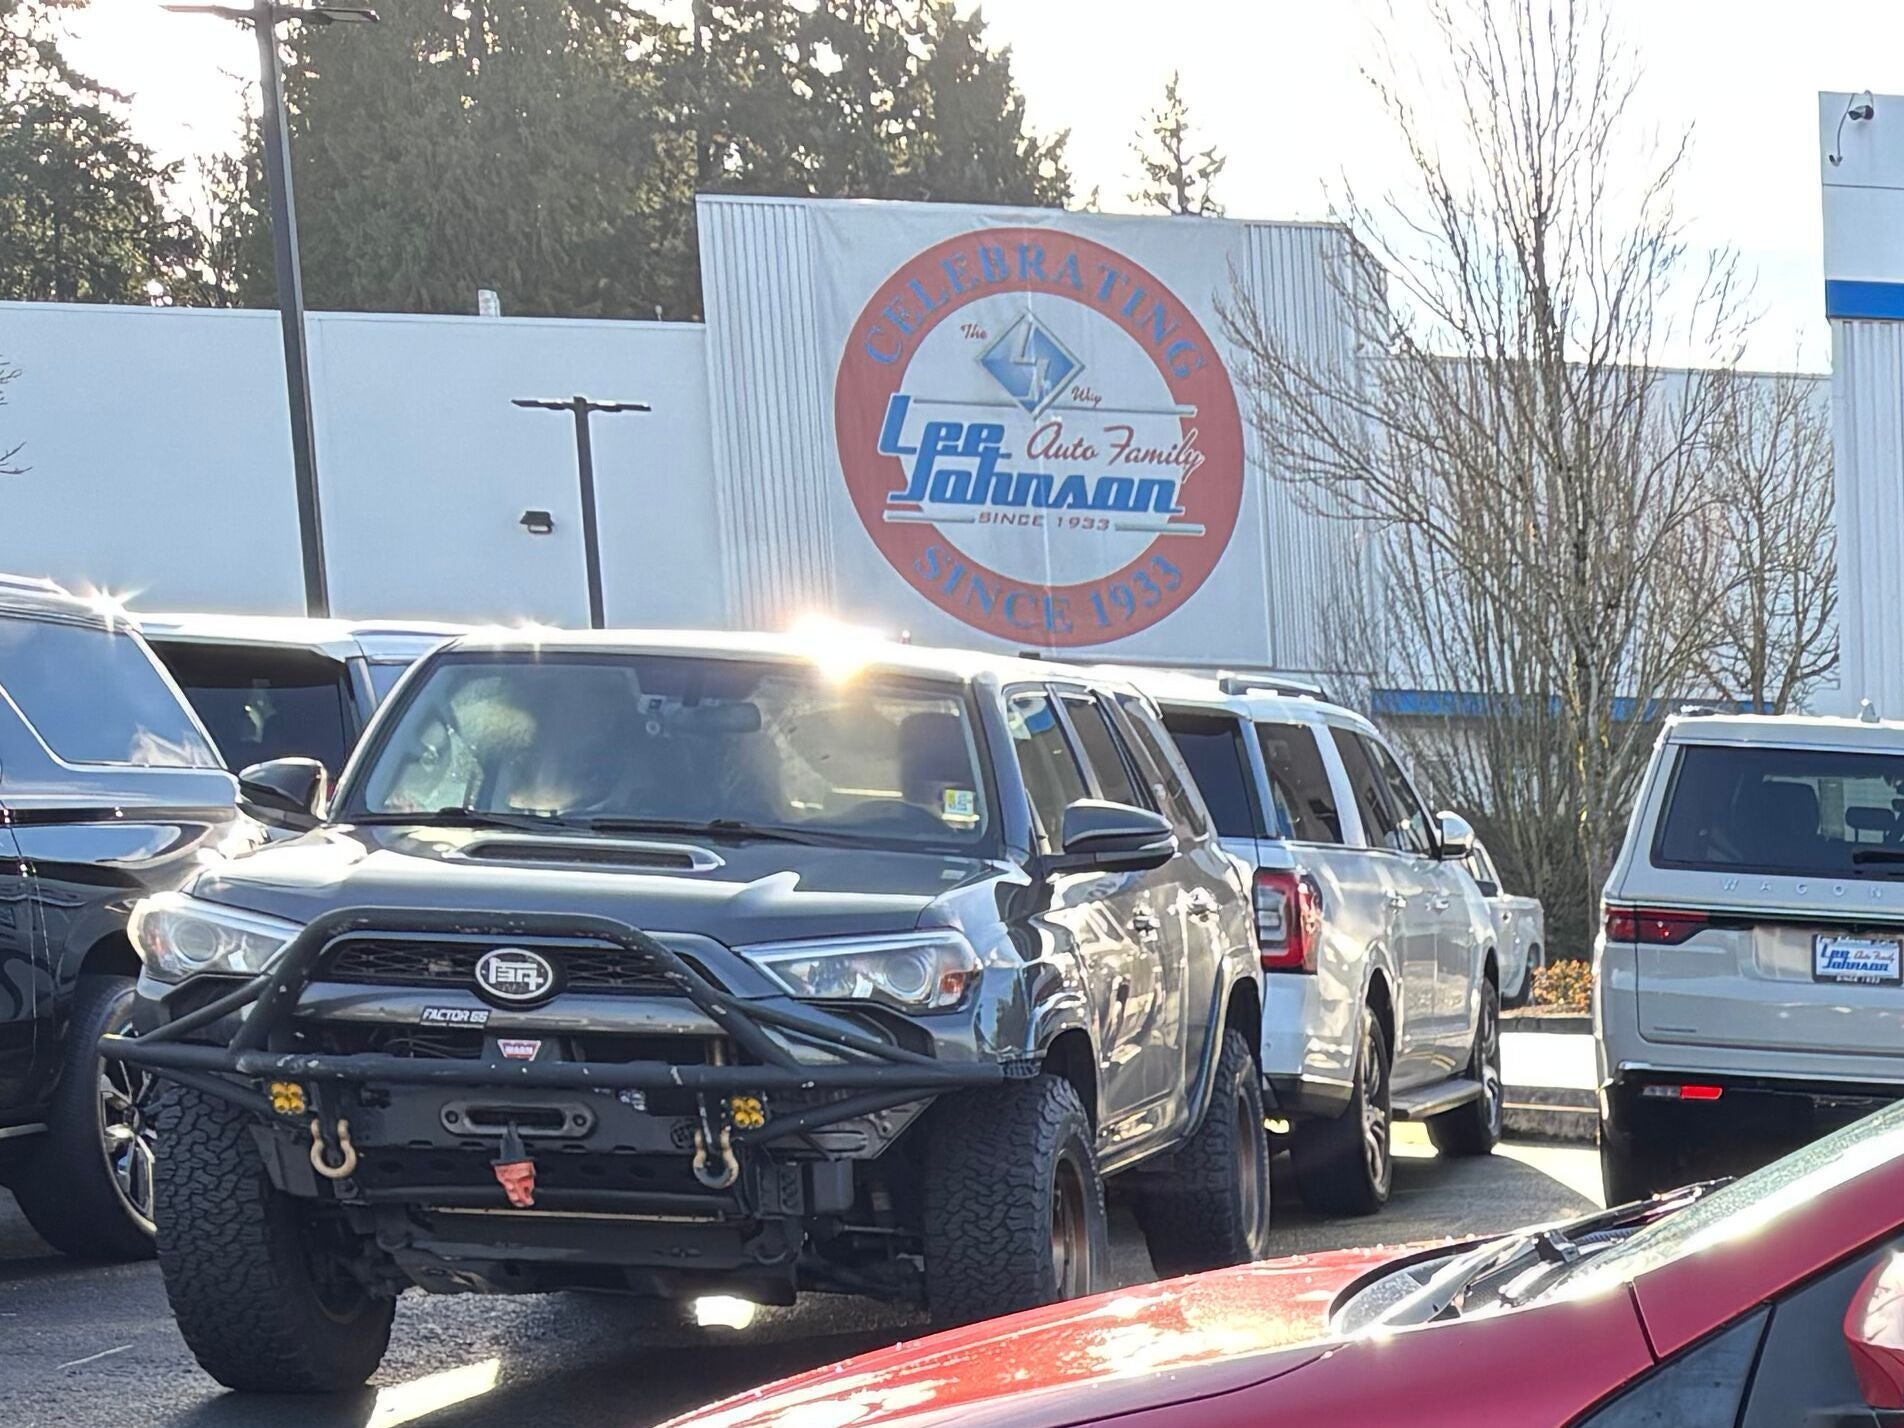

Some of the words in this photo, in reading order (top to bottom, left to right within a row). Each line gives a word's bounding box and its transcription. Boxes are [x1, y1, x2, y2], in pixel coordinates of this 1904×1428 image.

[864, 241, 1208, 380] CELEBRATING
[960, 323, 987, 340] The
[878, 395, 1012, 460] Lee
[1071, 385, 1103, 409] Way
[889, 450, 1185, 513] Johnson
[1026, 421, 1100, 460] Auto
[1103, 425, 1204, 482] Family
[977, 511, 1045, 527] SINCE
[1056, 514, 1110, 531] 1933
[914, 543, 1073, 633] SINCE
[1089, 554, 1182, 627] 1933
[421, 1008, 470, 1022] FACTOR
